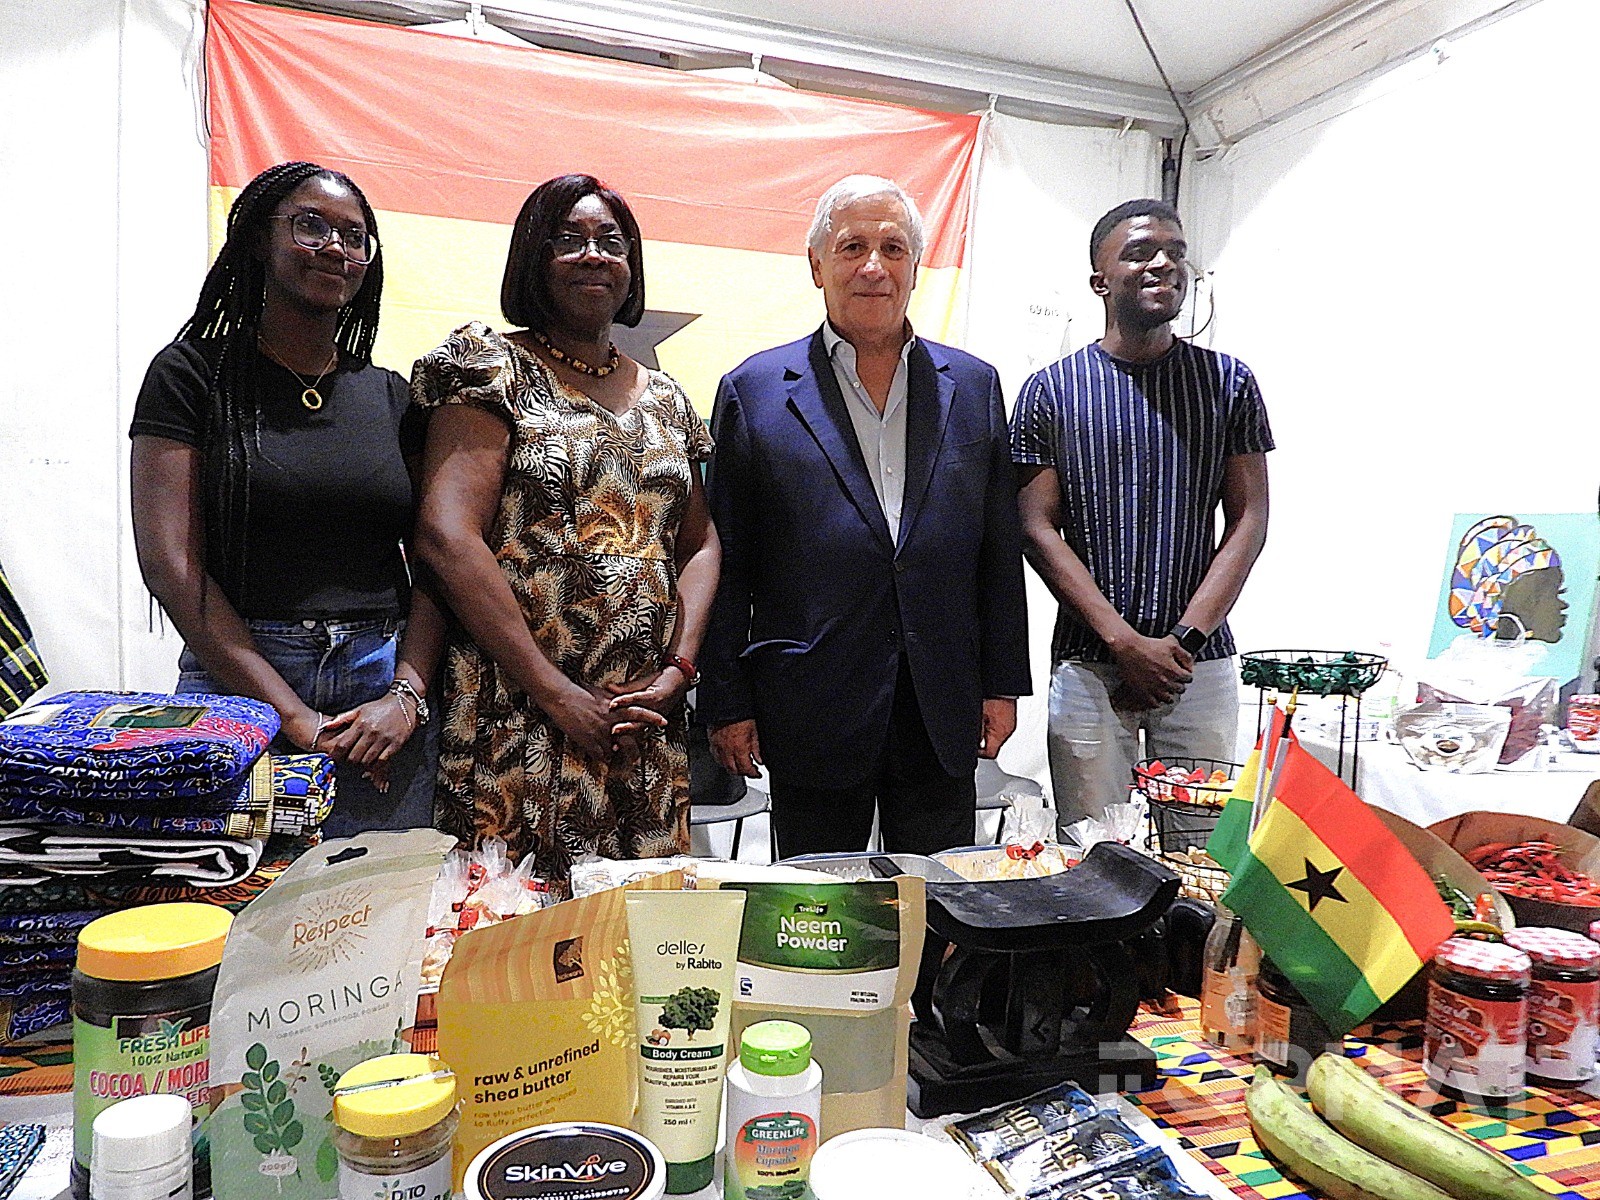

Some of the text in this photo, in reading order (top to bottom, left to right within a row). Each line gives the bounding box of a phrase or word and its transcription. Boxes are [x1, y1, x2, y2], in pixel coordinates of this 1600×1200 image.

[292, 904, 373, 949] Respect
[780, 916, 842, 935] Neem
[776, 932, 848, 952] Powder
[675, 957, 723, 971] by Rabito
[247, 969, 403, 1033] MORINGA
[132, 1044, 204, 1067] 100% Natural
[474, 1038, 600, 1087] raw & unrefined
[652, 1048, 712, 1061] Body Cream
[89, 1069, 147, 1099] COCOA
[474, 1069, 572, 1104] shea butter
[663, 1118, 677, 1126] 250
[751, 1127, 805, 1140] GREENLife
[505, 1156, 628, 1183] SkinVive
